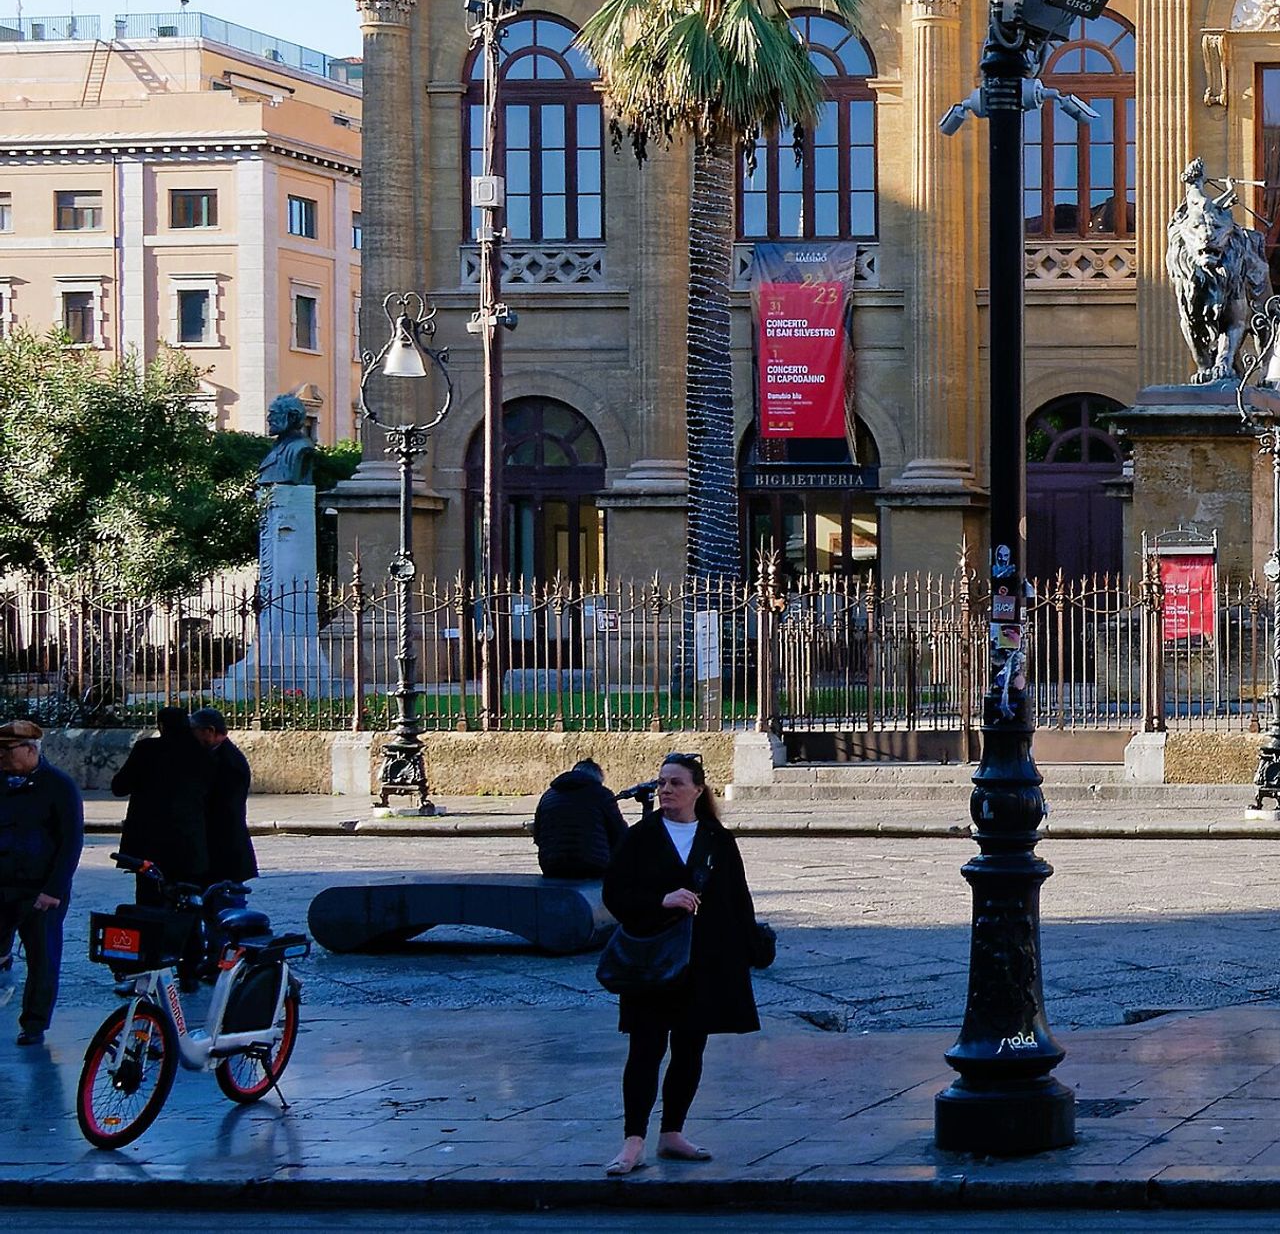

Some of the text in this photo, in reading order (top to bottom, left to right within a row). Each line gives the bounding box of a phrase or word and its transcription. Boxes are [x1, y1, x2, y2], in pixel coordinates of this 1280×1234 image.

[814, 287, 838, 304] 23
[766, 319, 808, 328] CONCERTO
[766, 328, 836, 337] DI SAN SILVESTRO
[767, 365, 808, 374] CONCERTO
[767, 374, 826, 383] DI CAPODANNO
[755, 474, 864, 486] BIGLIETTERIA
